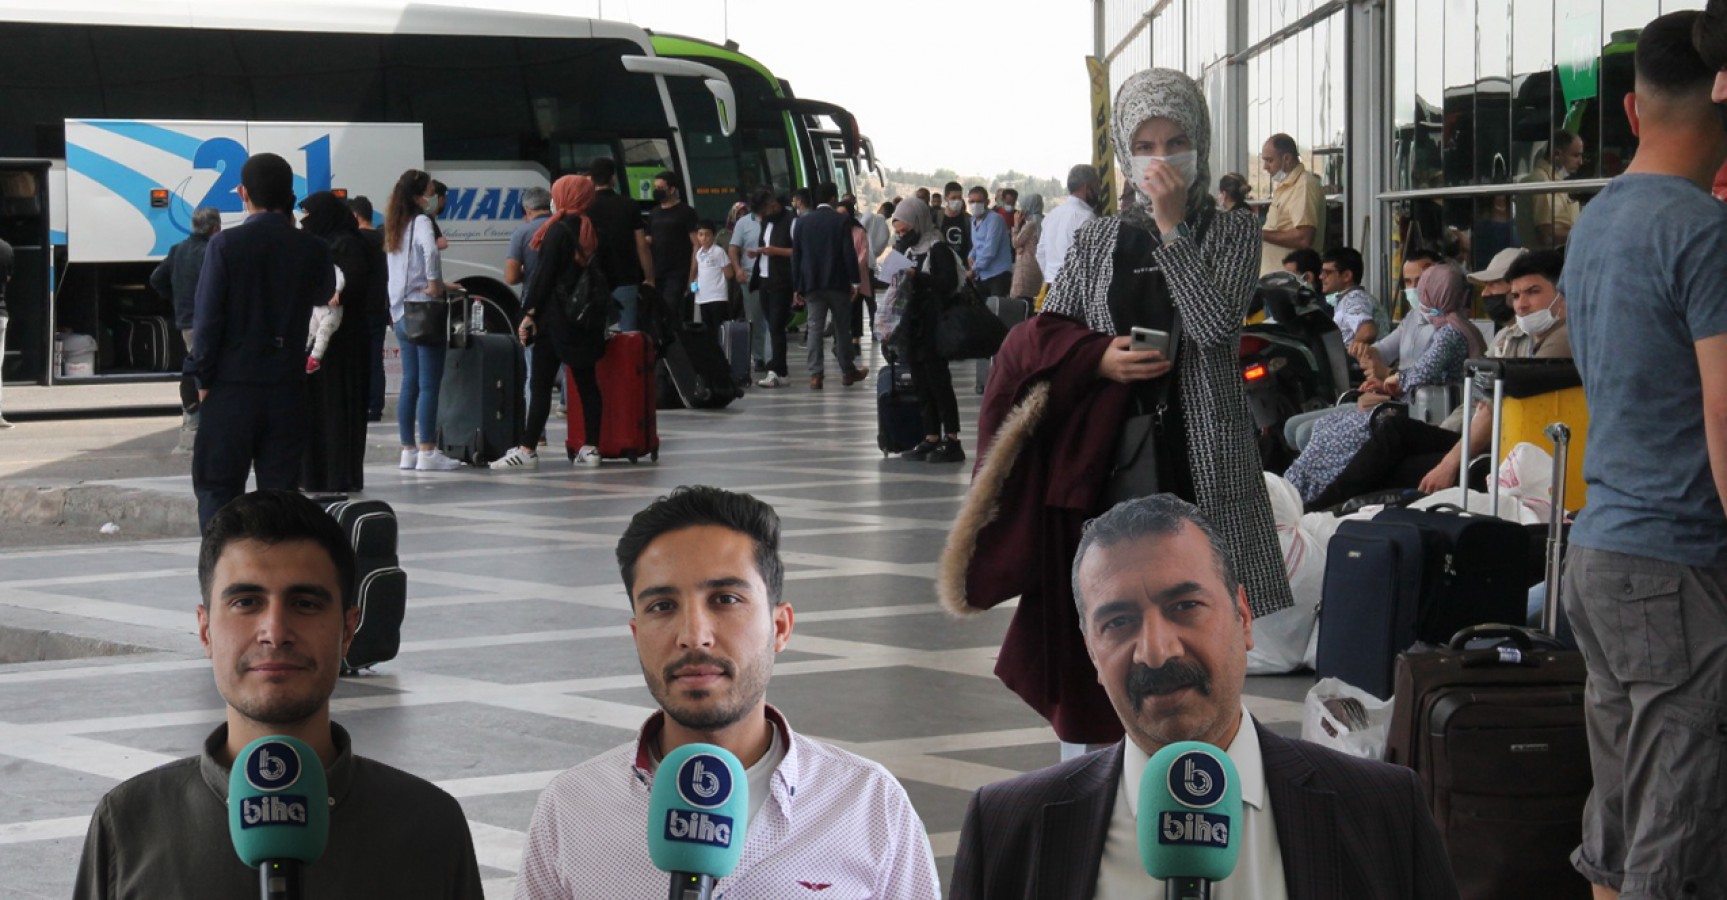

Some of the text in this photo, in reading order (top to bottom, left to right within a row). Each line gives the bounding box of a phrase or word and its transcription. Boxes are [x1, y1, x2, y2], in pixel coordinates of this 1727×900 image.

[437, 187, 527, 220] MAN
[946, 226, 962, 245] G
[243, 796, 306, 824] biha
[669, 810, 730, 845] biha
[1163, 812, 1228, 844] biha
